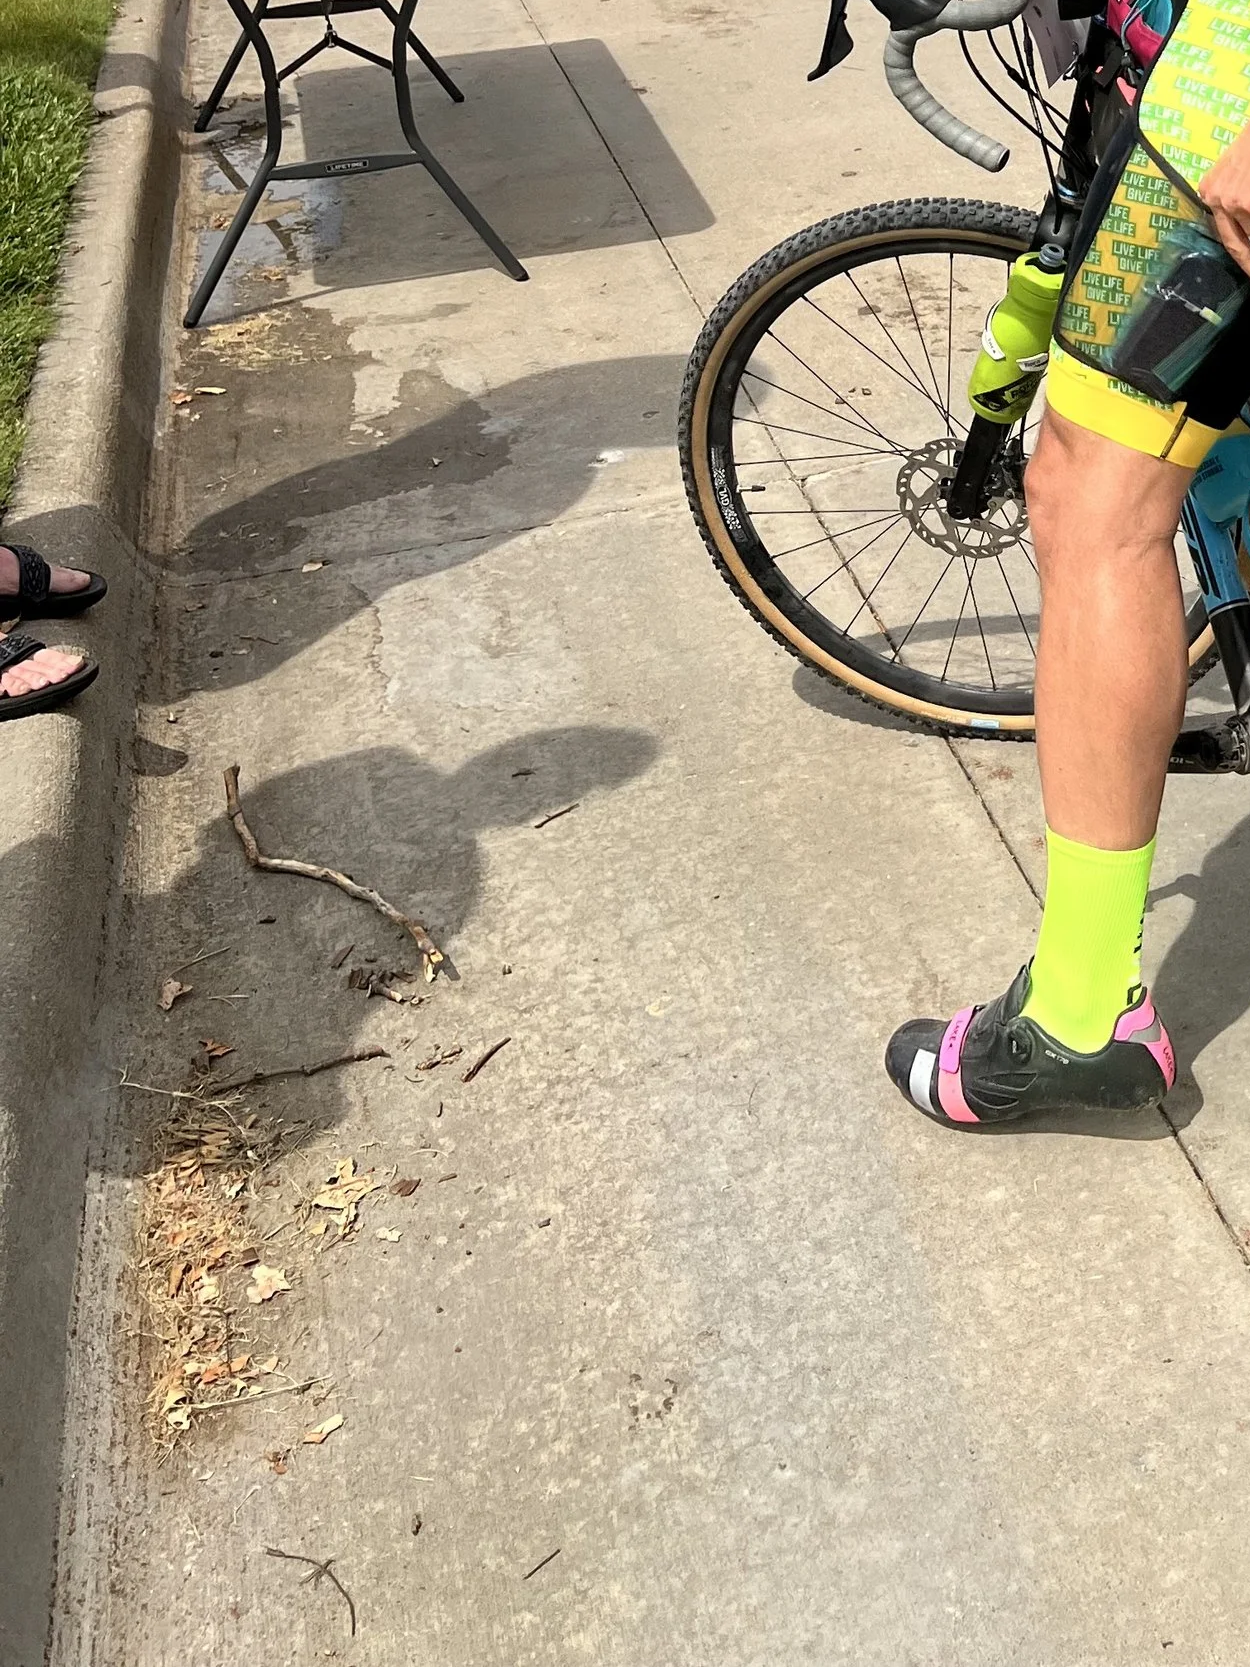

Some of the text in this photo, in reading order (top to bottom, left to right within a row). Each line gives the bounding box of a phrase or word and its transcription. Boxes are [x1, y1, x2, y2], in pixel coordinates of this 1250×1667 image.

[1211, 18, 1244, 34] LIVE
[1181, 42, 1211, 60] LIFE
[1214, 35, 1248, 54] GIVE
[1183, 57, 1216, 76] LIFE
[1176, 76, 1248, 111] LIVE LIFE
[1181, 94, 1214, 113] GIVE
[1155, 106, 1184, 123] LIFE
[1162, 124, 1191, 142] LIFE
[1213, 126, 1235, 143] LIV
[1162, 144, 1188, 164] LIVE
[1123, 173, 1171, 194] LIVE LIFE
[1126, 187, 1178, 209] GIVE LIFE
[1109, 204, 1129, 220] LIFE
[1114, 221, 1136, 237] LIFE
[1150, 214, 1176, 230] LIVE
[1113, 241, 1137, 258] LIVE
[1118, 257, 1144, 274] GIVE
[1083, 270, 1124, 291] LIVE LIFE
[1087, 286, 1132, 306] GIVE LIFE
[1072, 304, 1090, 320] LIFE
[1076, 319, 1096, 336] LIFE
